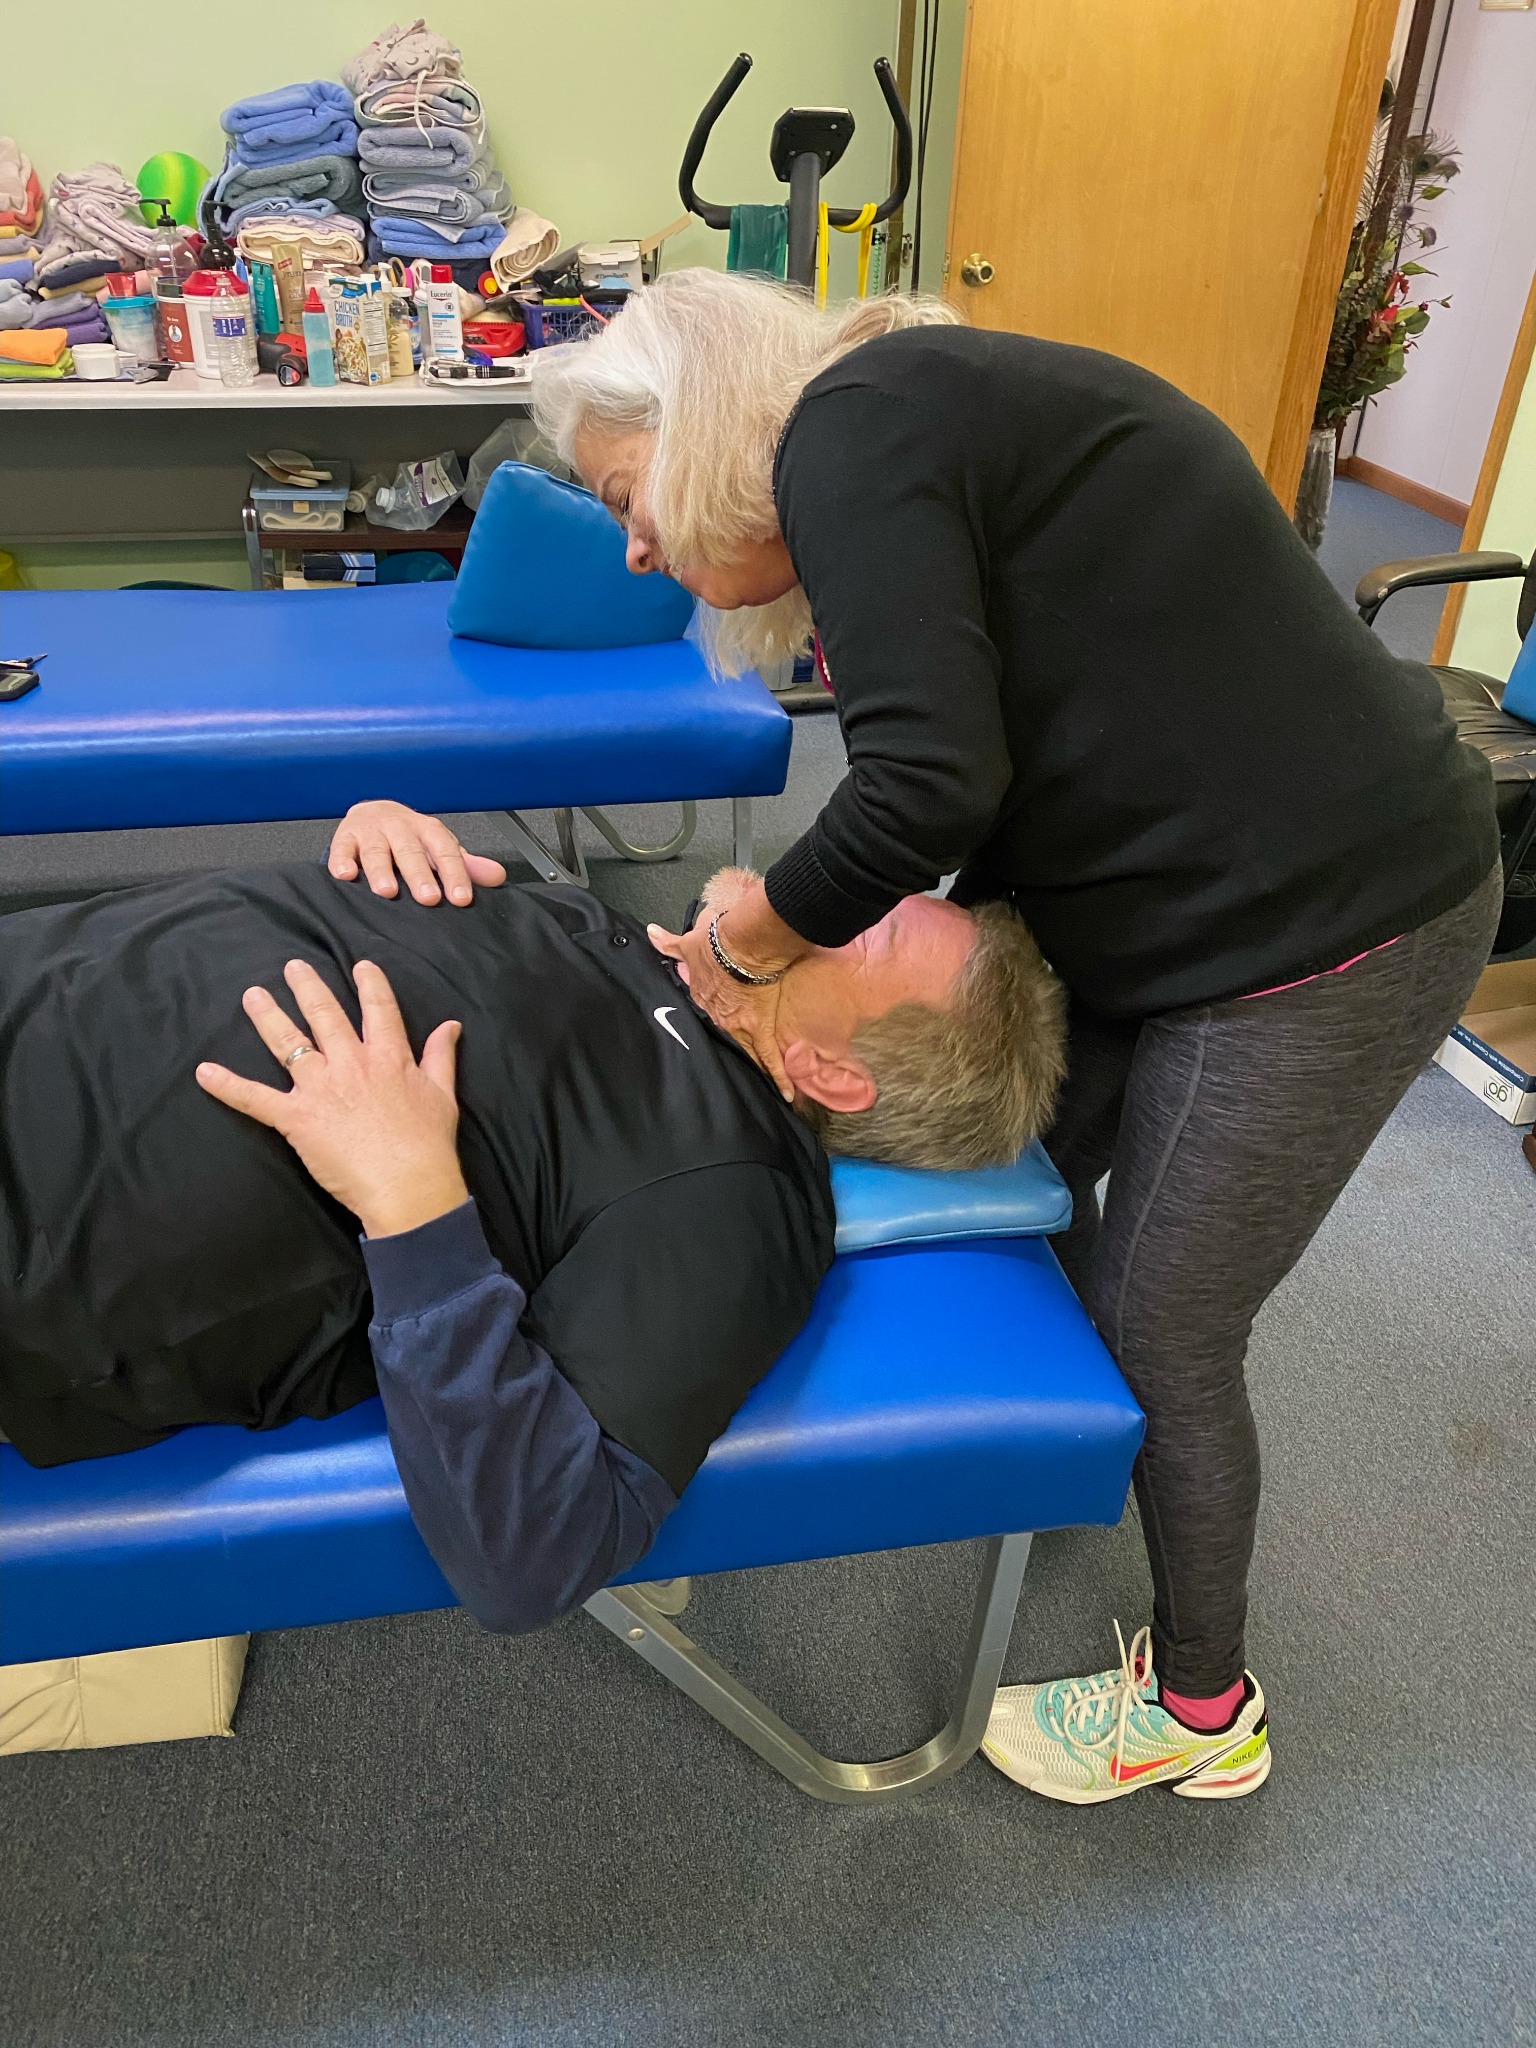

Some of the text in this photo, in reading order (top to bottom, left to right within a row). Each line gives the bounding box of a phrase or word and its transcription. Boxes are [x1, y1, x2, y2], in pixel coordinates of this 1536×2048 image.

[430, 290, 452, 298] Eucerin
[334, 300, 360, 315] CHICKEN
[336, 314, 353, 327] BROTH
[1488, 1082, 1509, 1103] go
[1232, 1751, 1252, 1764] NIKE
